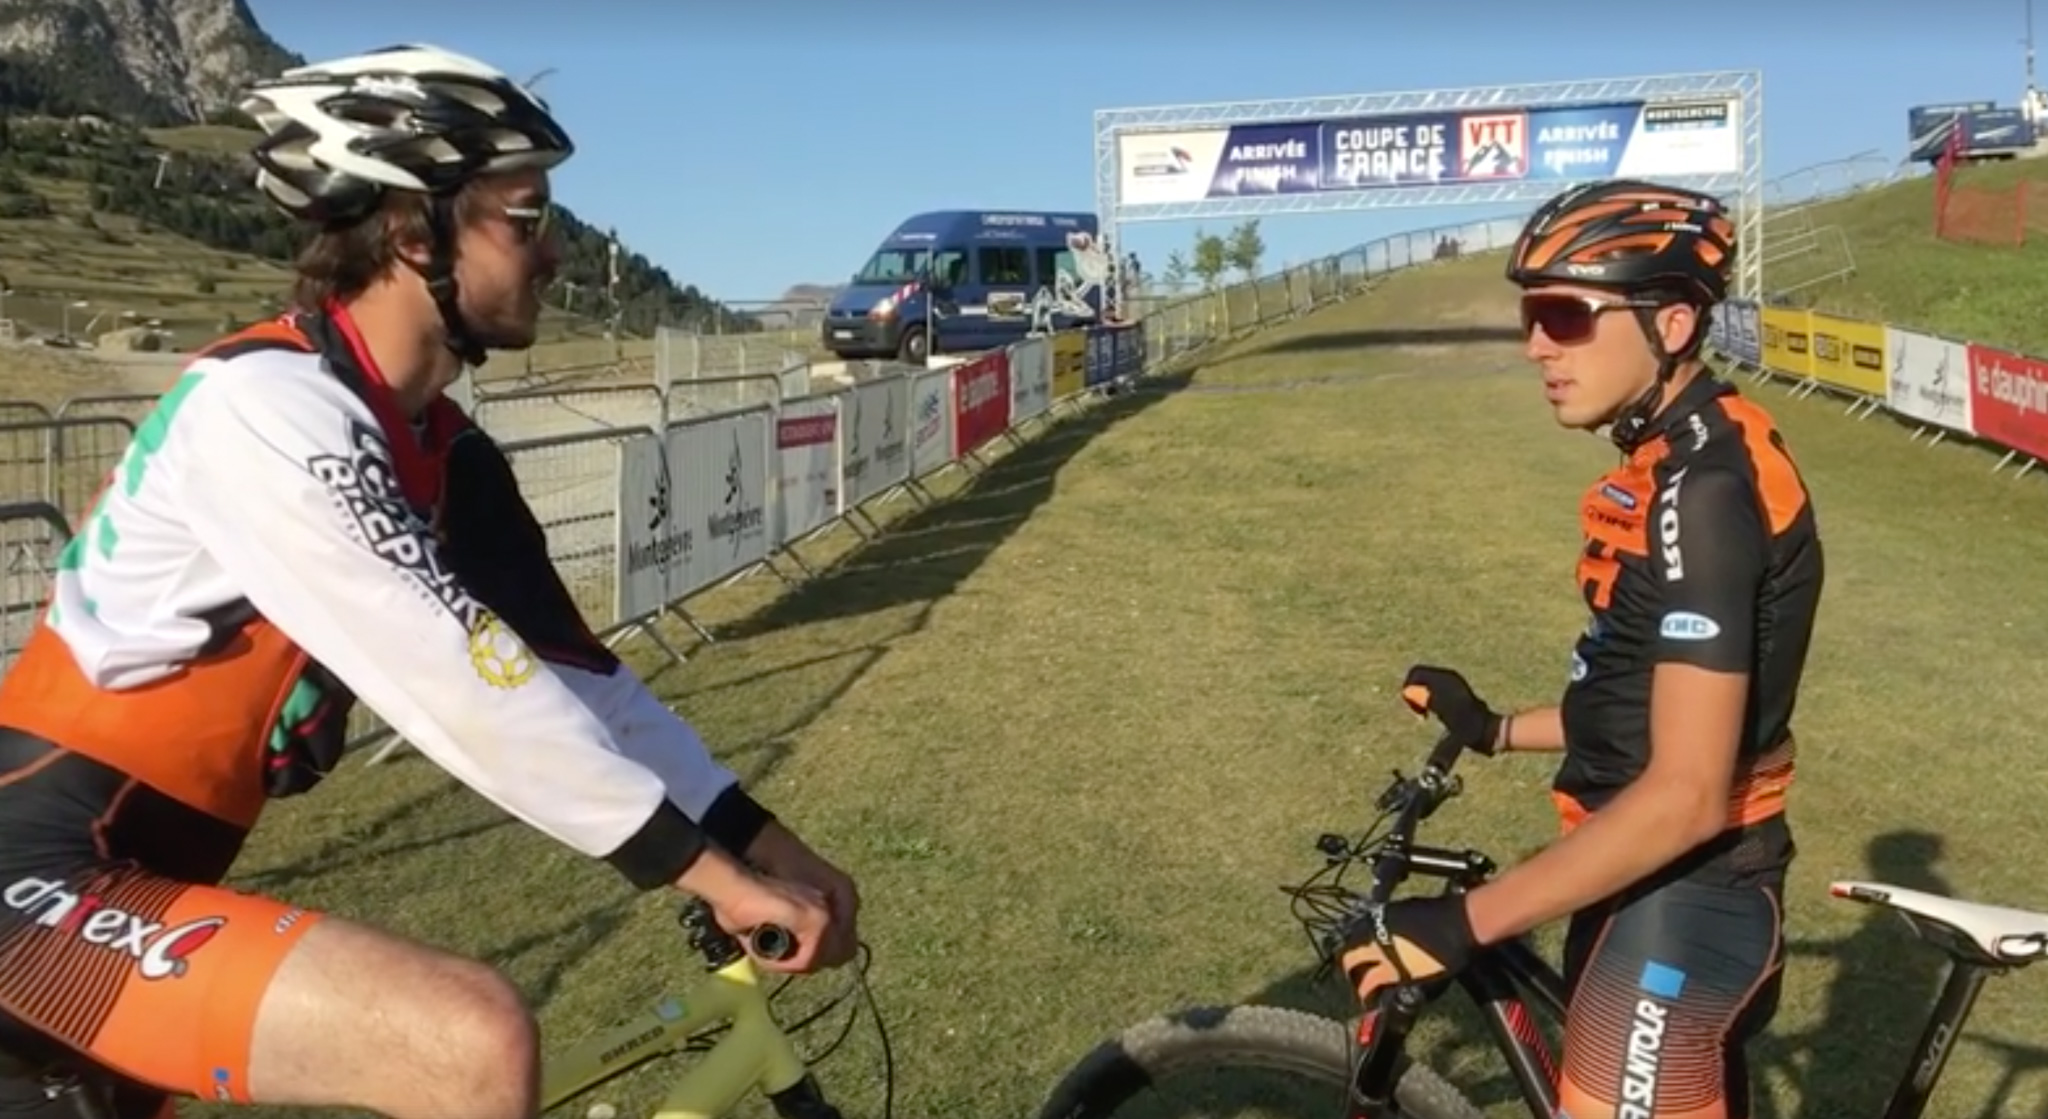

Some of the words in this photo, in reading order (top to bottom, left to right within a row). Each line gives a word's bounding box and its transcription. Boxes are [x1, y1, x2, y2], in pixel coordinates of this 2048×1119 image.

[1335, 127, 1408, 150] COUPE
[1416, 123, 1446, 146] DE
[1469, 119, 1516, 146] VTT
[1537, 119, 1619, 143] ARRIVÉE
[1229, 138, 1307, 161] ARRIVÉE
[1543, 147, 1609, 170] FINISH
[1236, 164, 1297, 184] FINISH
[1336, 147, 1446, 180] FRANCE
[1975, 352, 1990, 396] le
